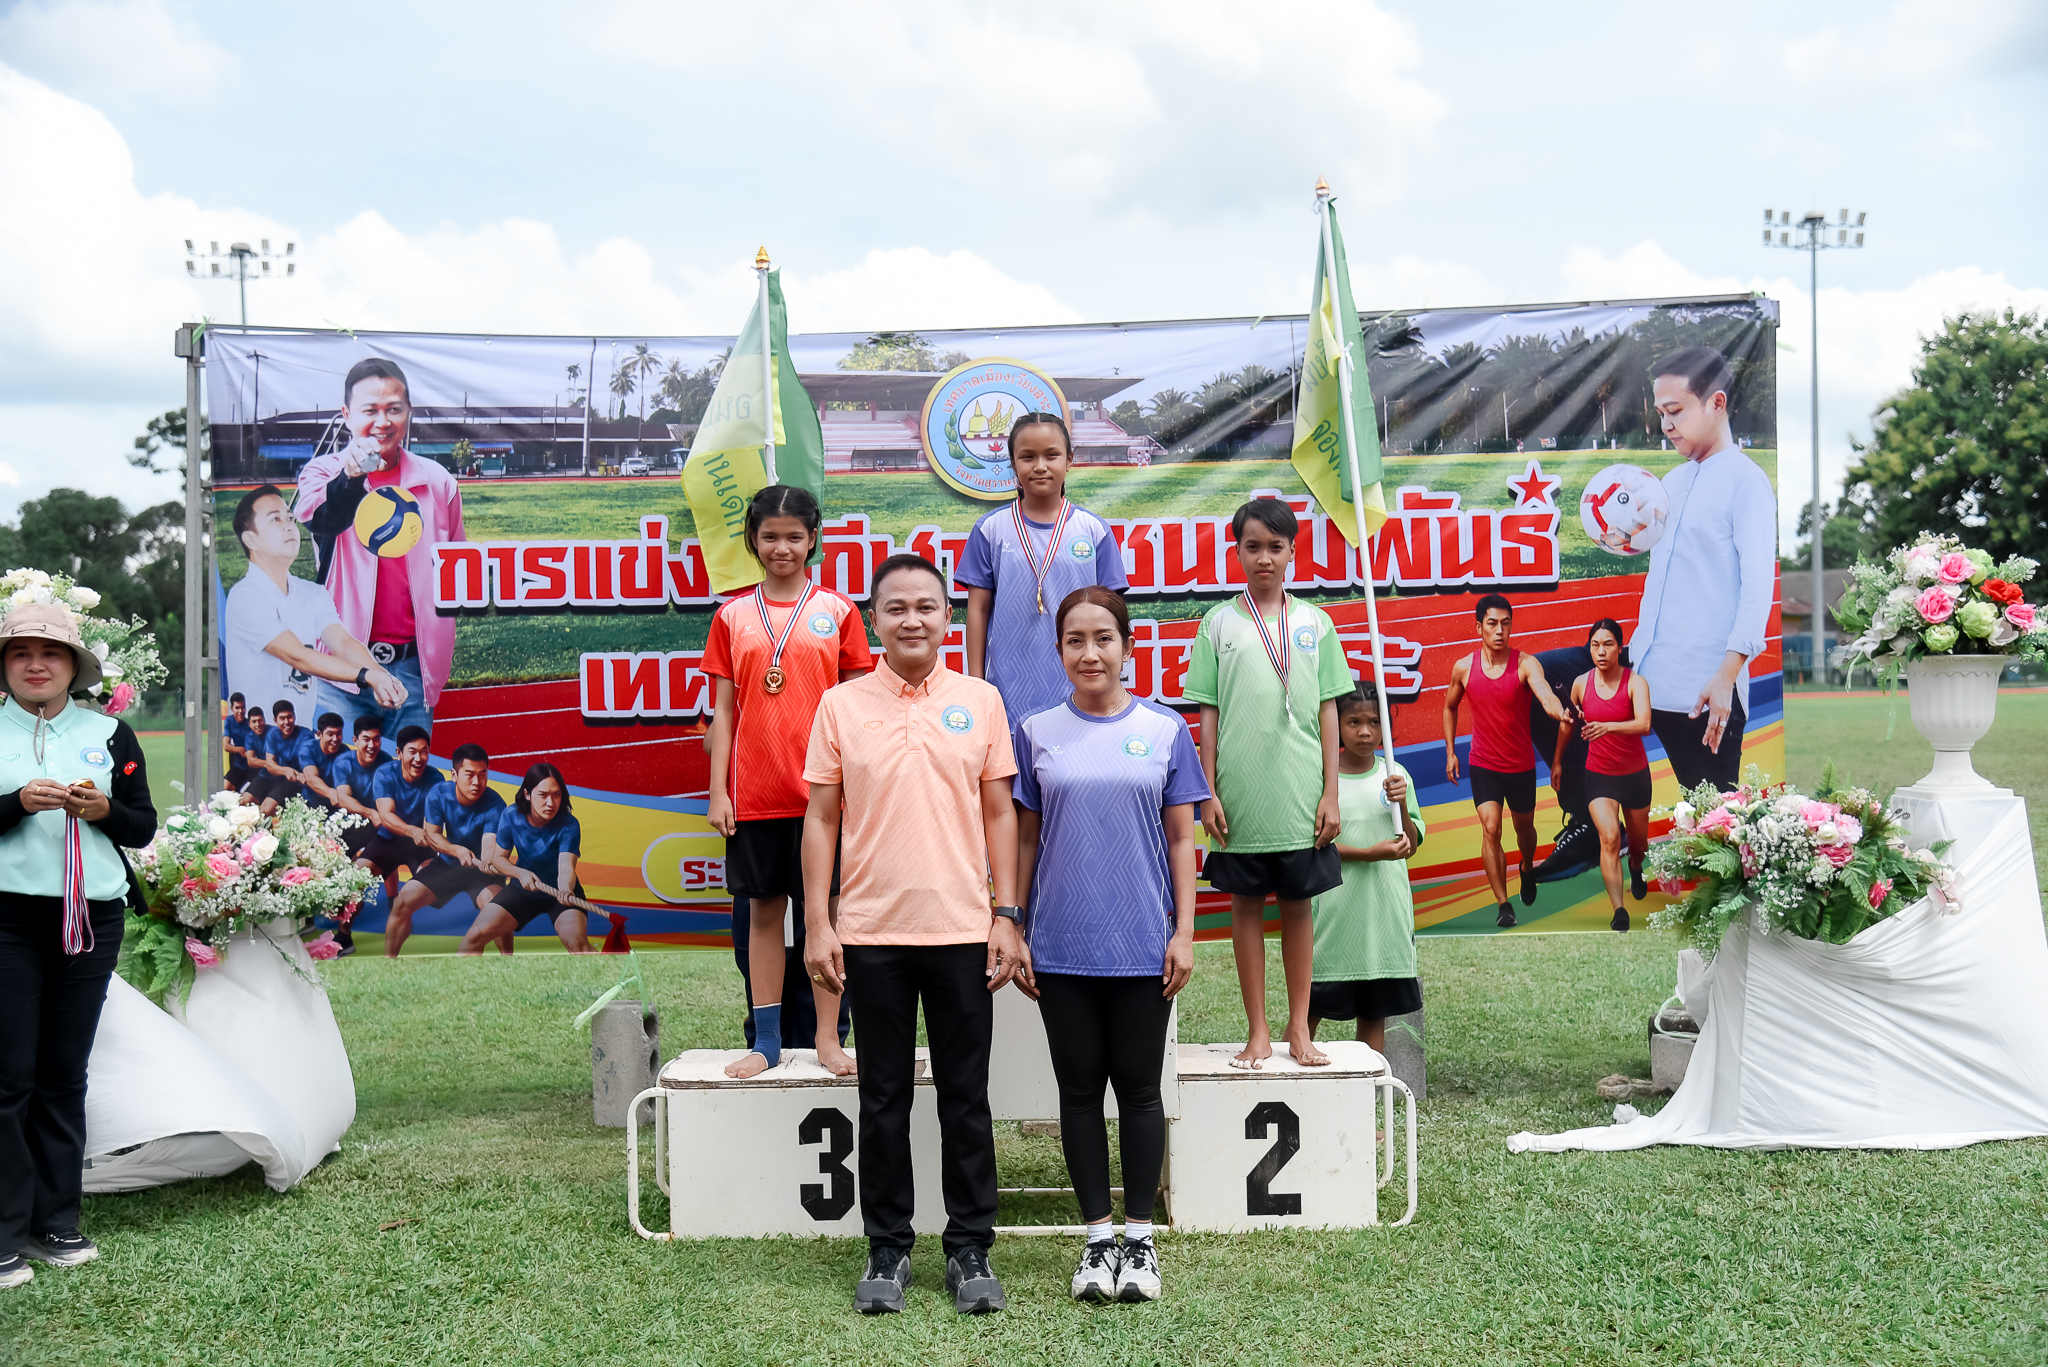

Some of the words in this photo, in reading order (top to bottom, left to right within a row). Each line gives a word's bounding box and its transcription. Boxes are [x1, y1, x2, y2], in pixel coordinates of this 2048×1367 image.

[941, 368, 1052, 413] เทศบาลเมืองเวียงสระ
[798, 1107, 855, 1221] 3
[1245, 1101, 1302, 1216] 2
